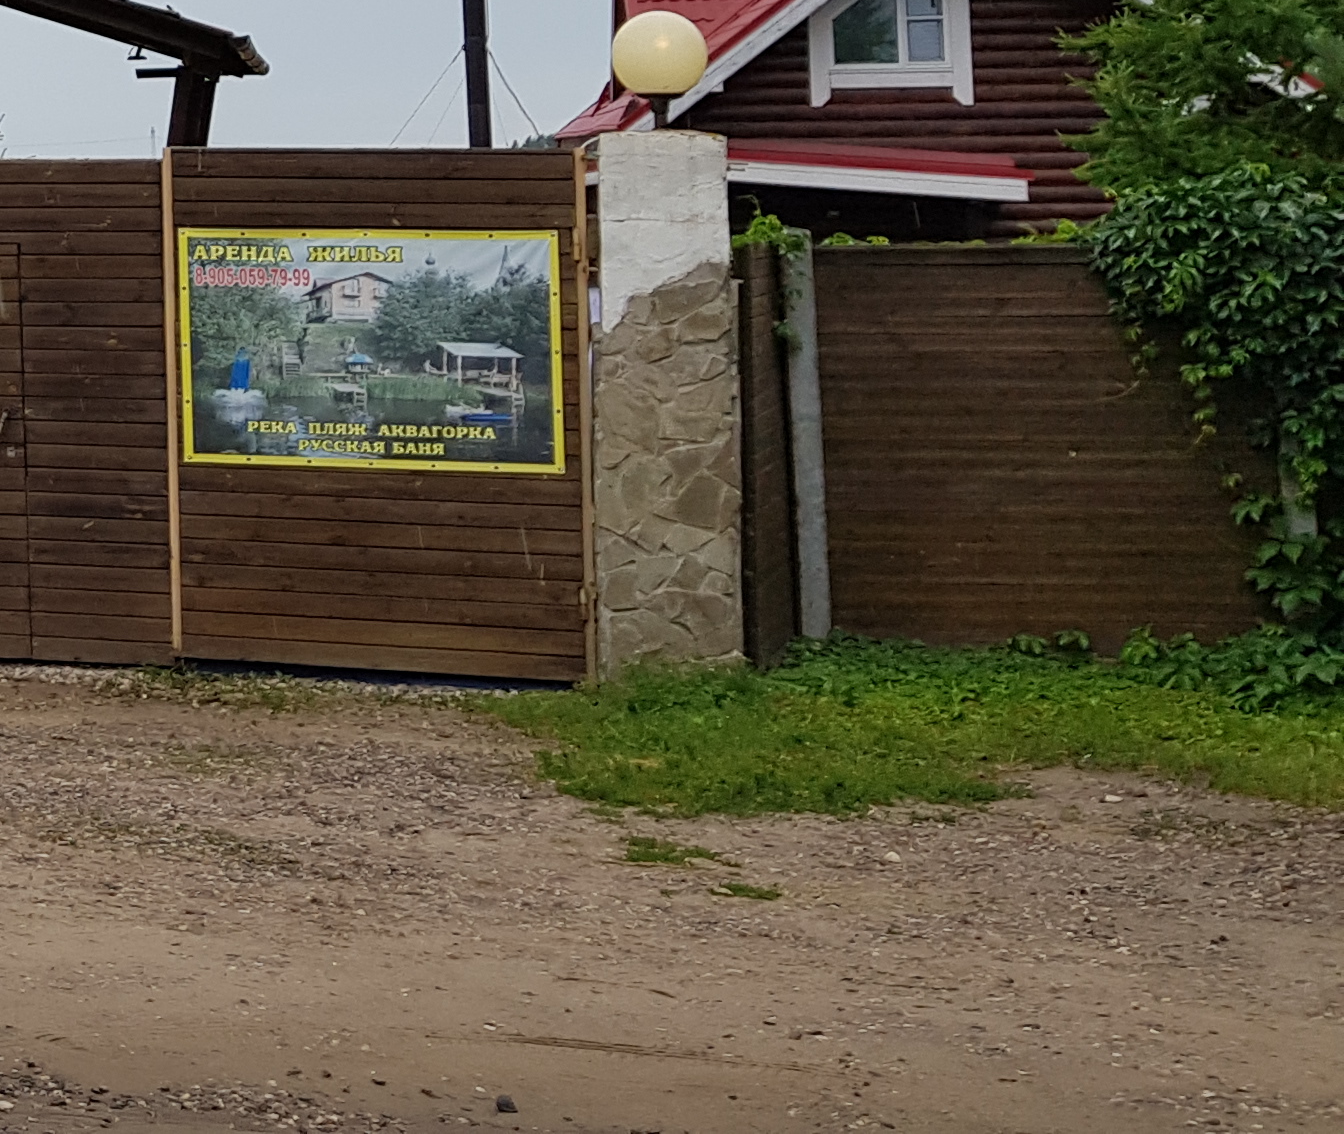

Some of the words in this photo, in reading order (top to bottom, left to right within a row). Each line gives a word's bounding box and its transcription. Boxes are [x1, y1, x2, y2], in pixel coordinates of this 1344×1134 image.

[193, 245, 293, 263] АРЕНДА
[308, 246, 404, 263] ЖИЛЬЯ
[195, 267, 311, 287] 8-905-059-79-99
[247, 421, 298, 434] РЕКА
[308, 422, 367, 436] ПЛЯЖ
[377, 424, 497, 440] АКВАГОРКА
[297, 439, 386, 454] РУССКАЯ
[391, 442, 446, 455] БАНЯ
